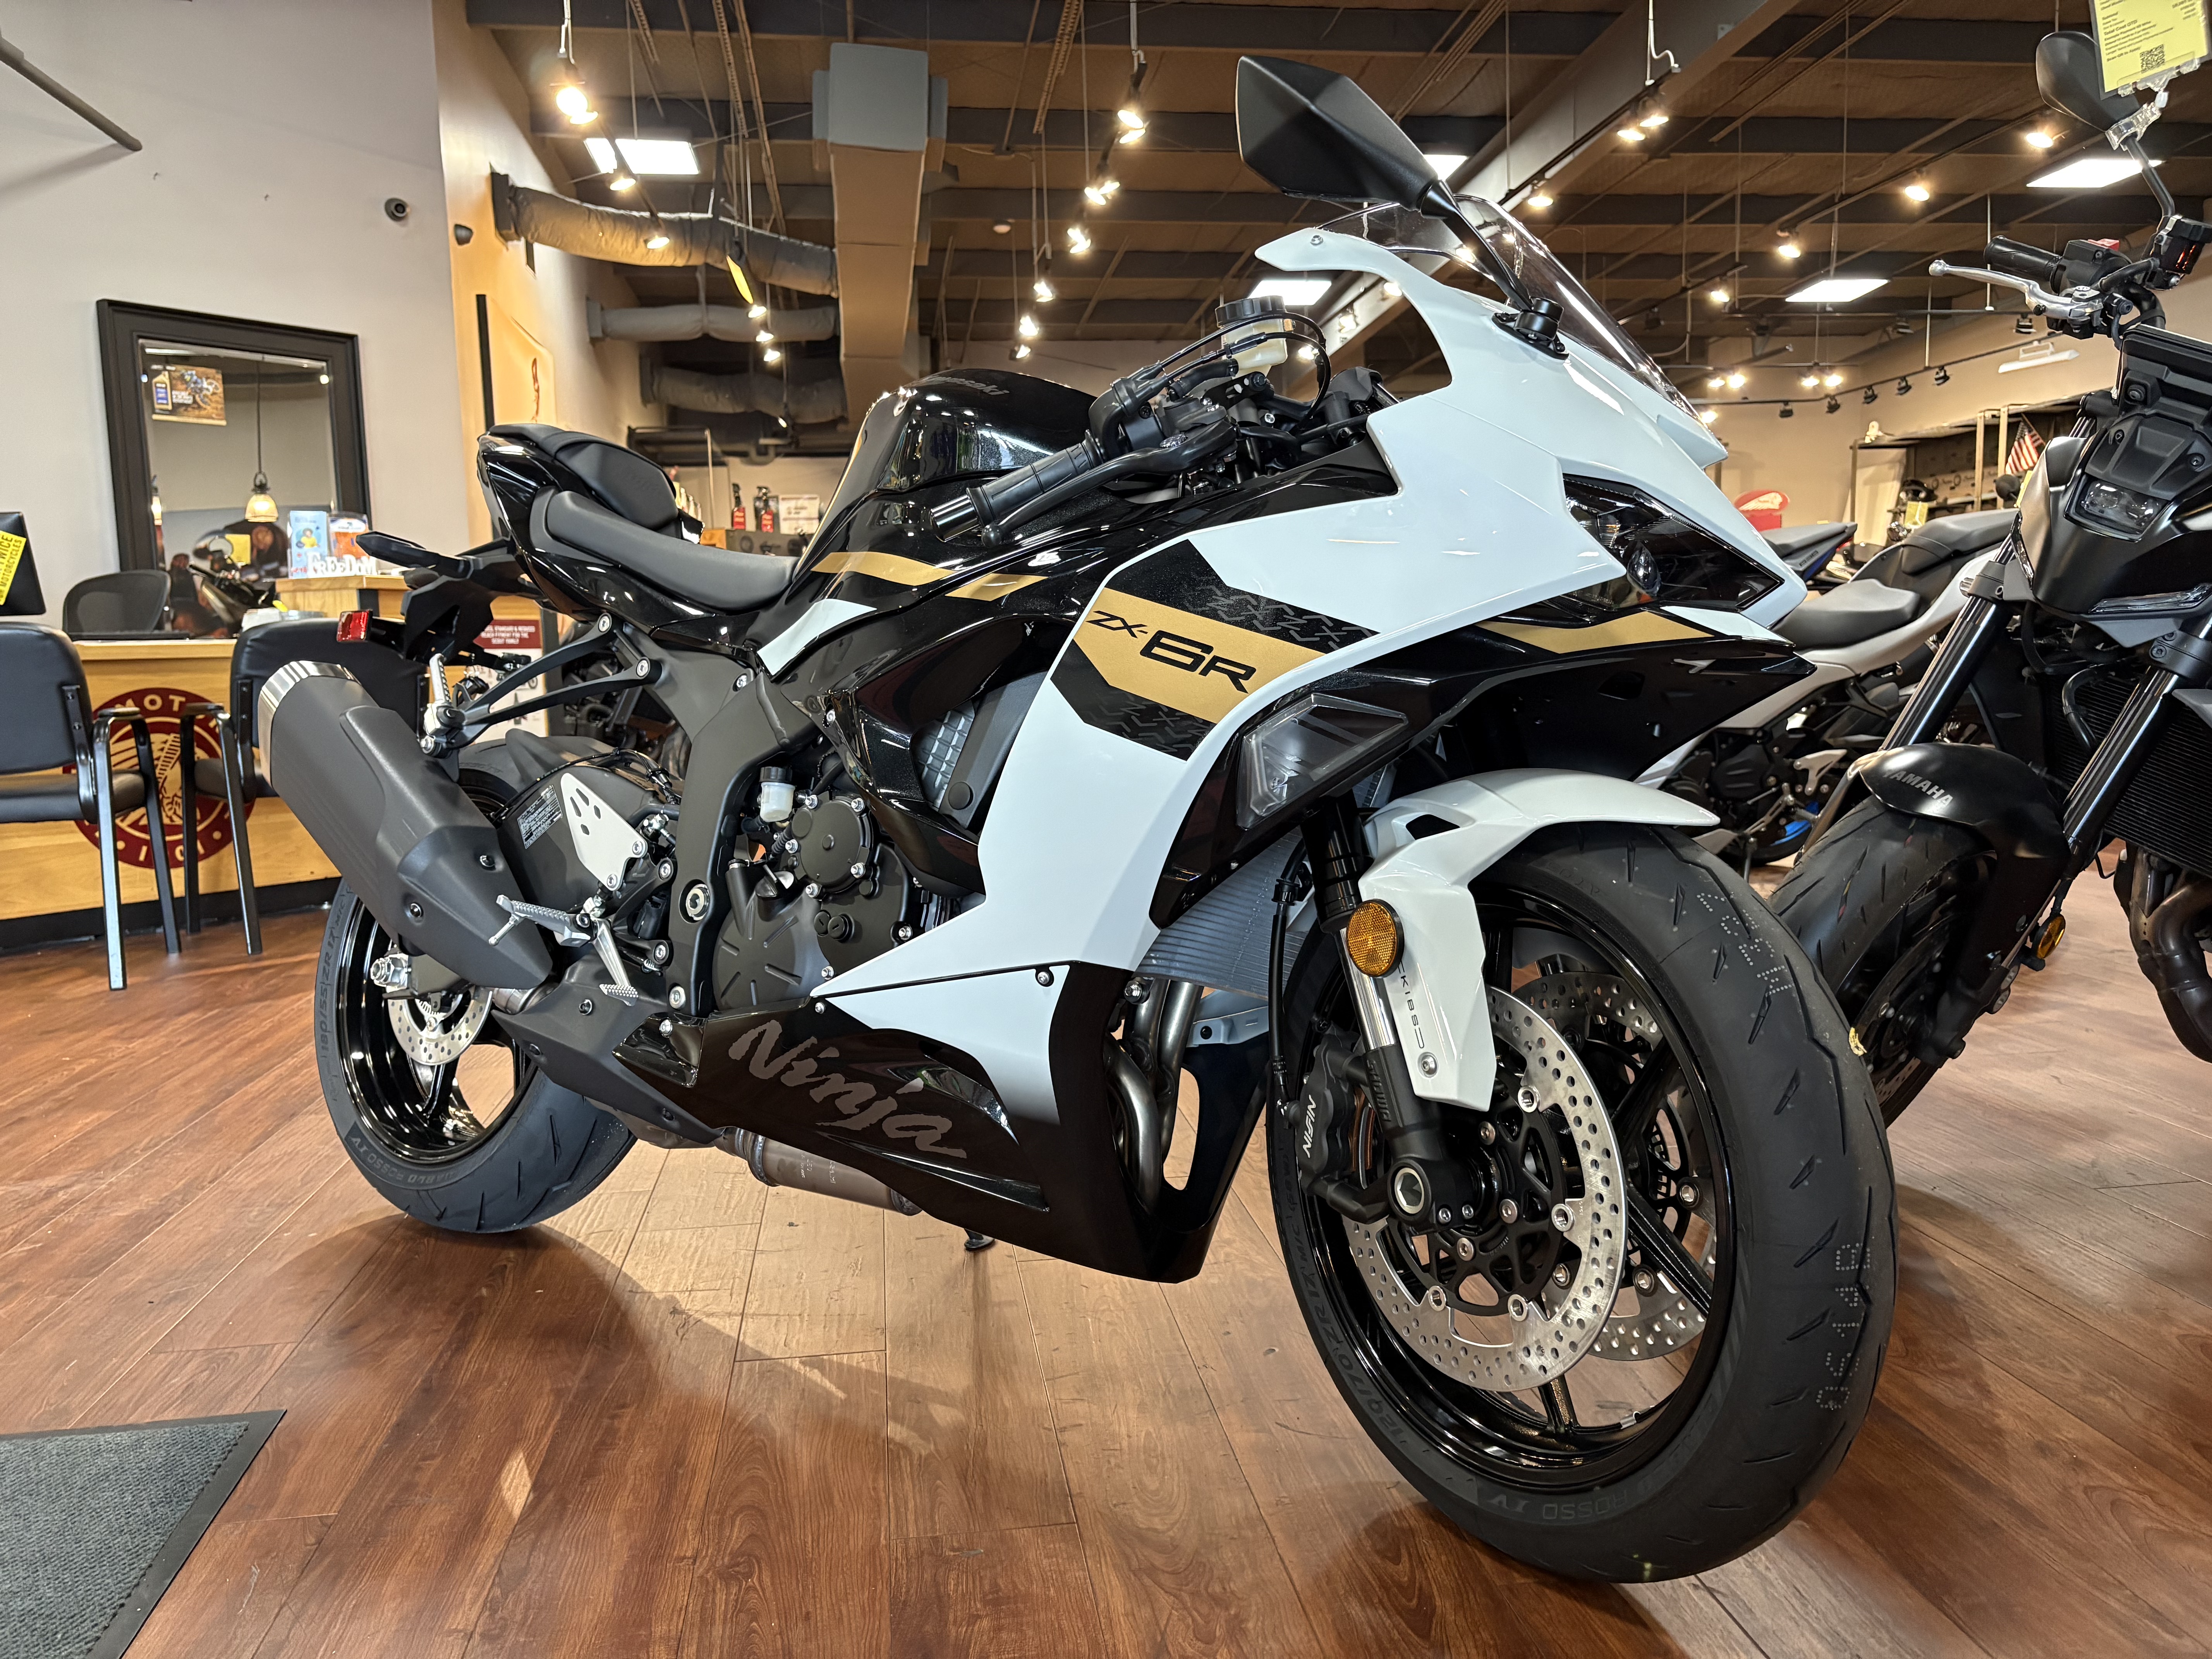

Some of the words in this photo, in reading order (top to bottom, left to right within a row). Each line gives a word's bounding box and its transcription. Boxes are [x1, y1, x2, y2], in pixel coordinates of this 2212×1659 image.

[307, 551, 378, 576] FREEDOM
[1085, 610, 1257, 694] ZX-6R
[1882, 769, 1954, 807] YAMAHA
[1400, 975, 1419, 1027] KIBS
[728, 1019, 967, 1159] Ninja
[1486, 1492, 1531, 1514] IV
[1541, 1488, 1628, 1520] ROSSO
